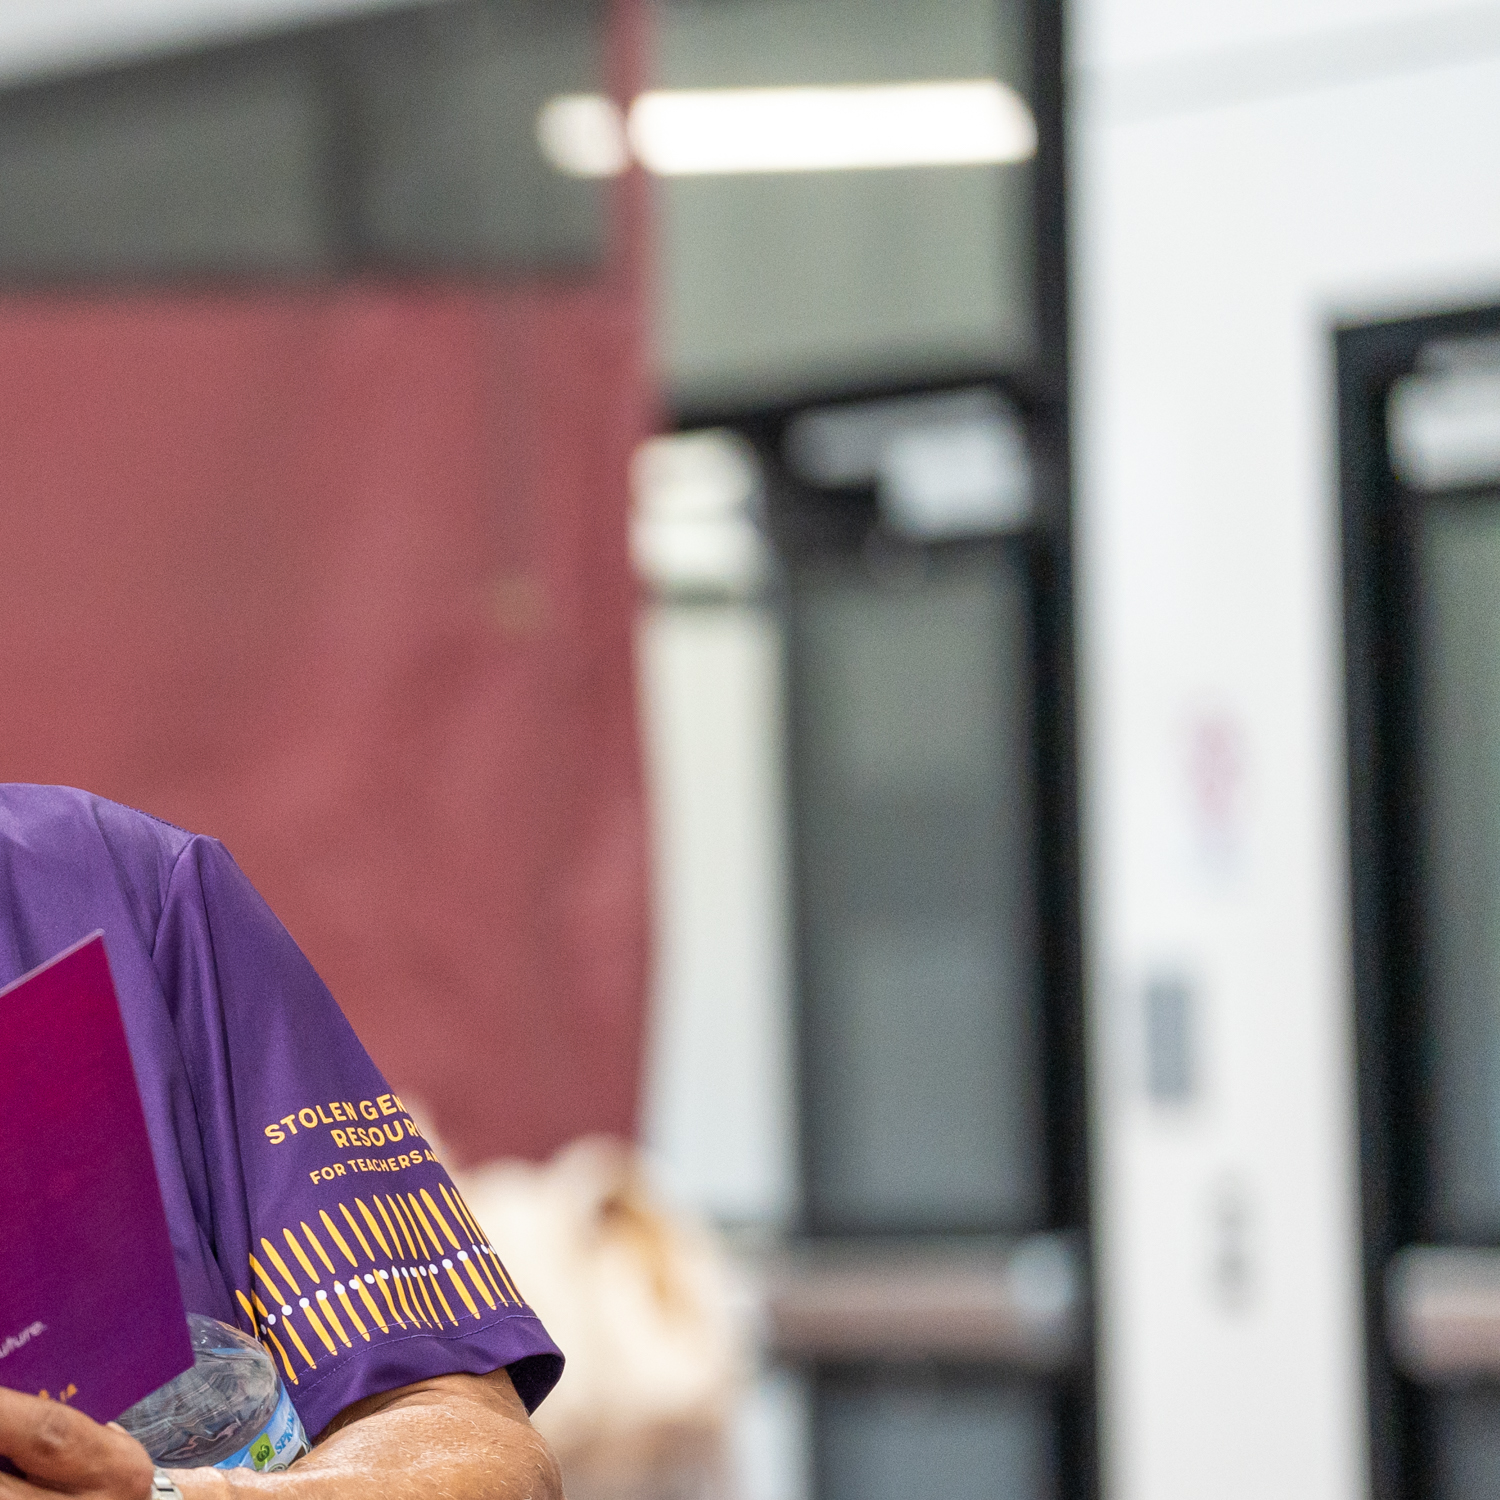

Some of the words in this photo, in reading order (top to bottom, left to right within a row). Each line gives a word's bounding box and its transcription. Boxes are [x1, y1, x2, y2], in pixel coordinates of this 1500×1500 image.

[264, 1101, 359, 1145] STOLEN
[309, 1163, 347, 1185] FOR
[347, 1150, 423, 1173] TEACHERS
